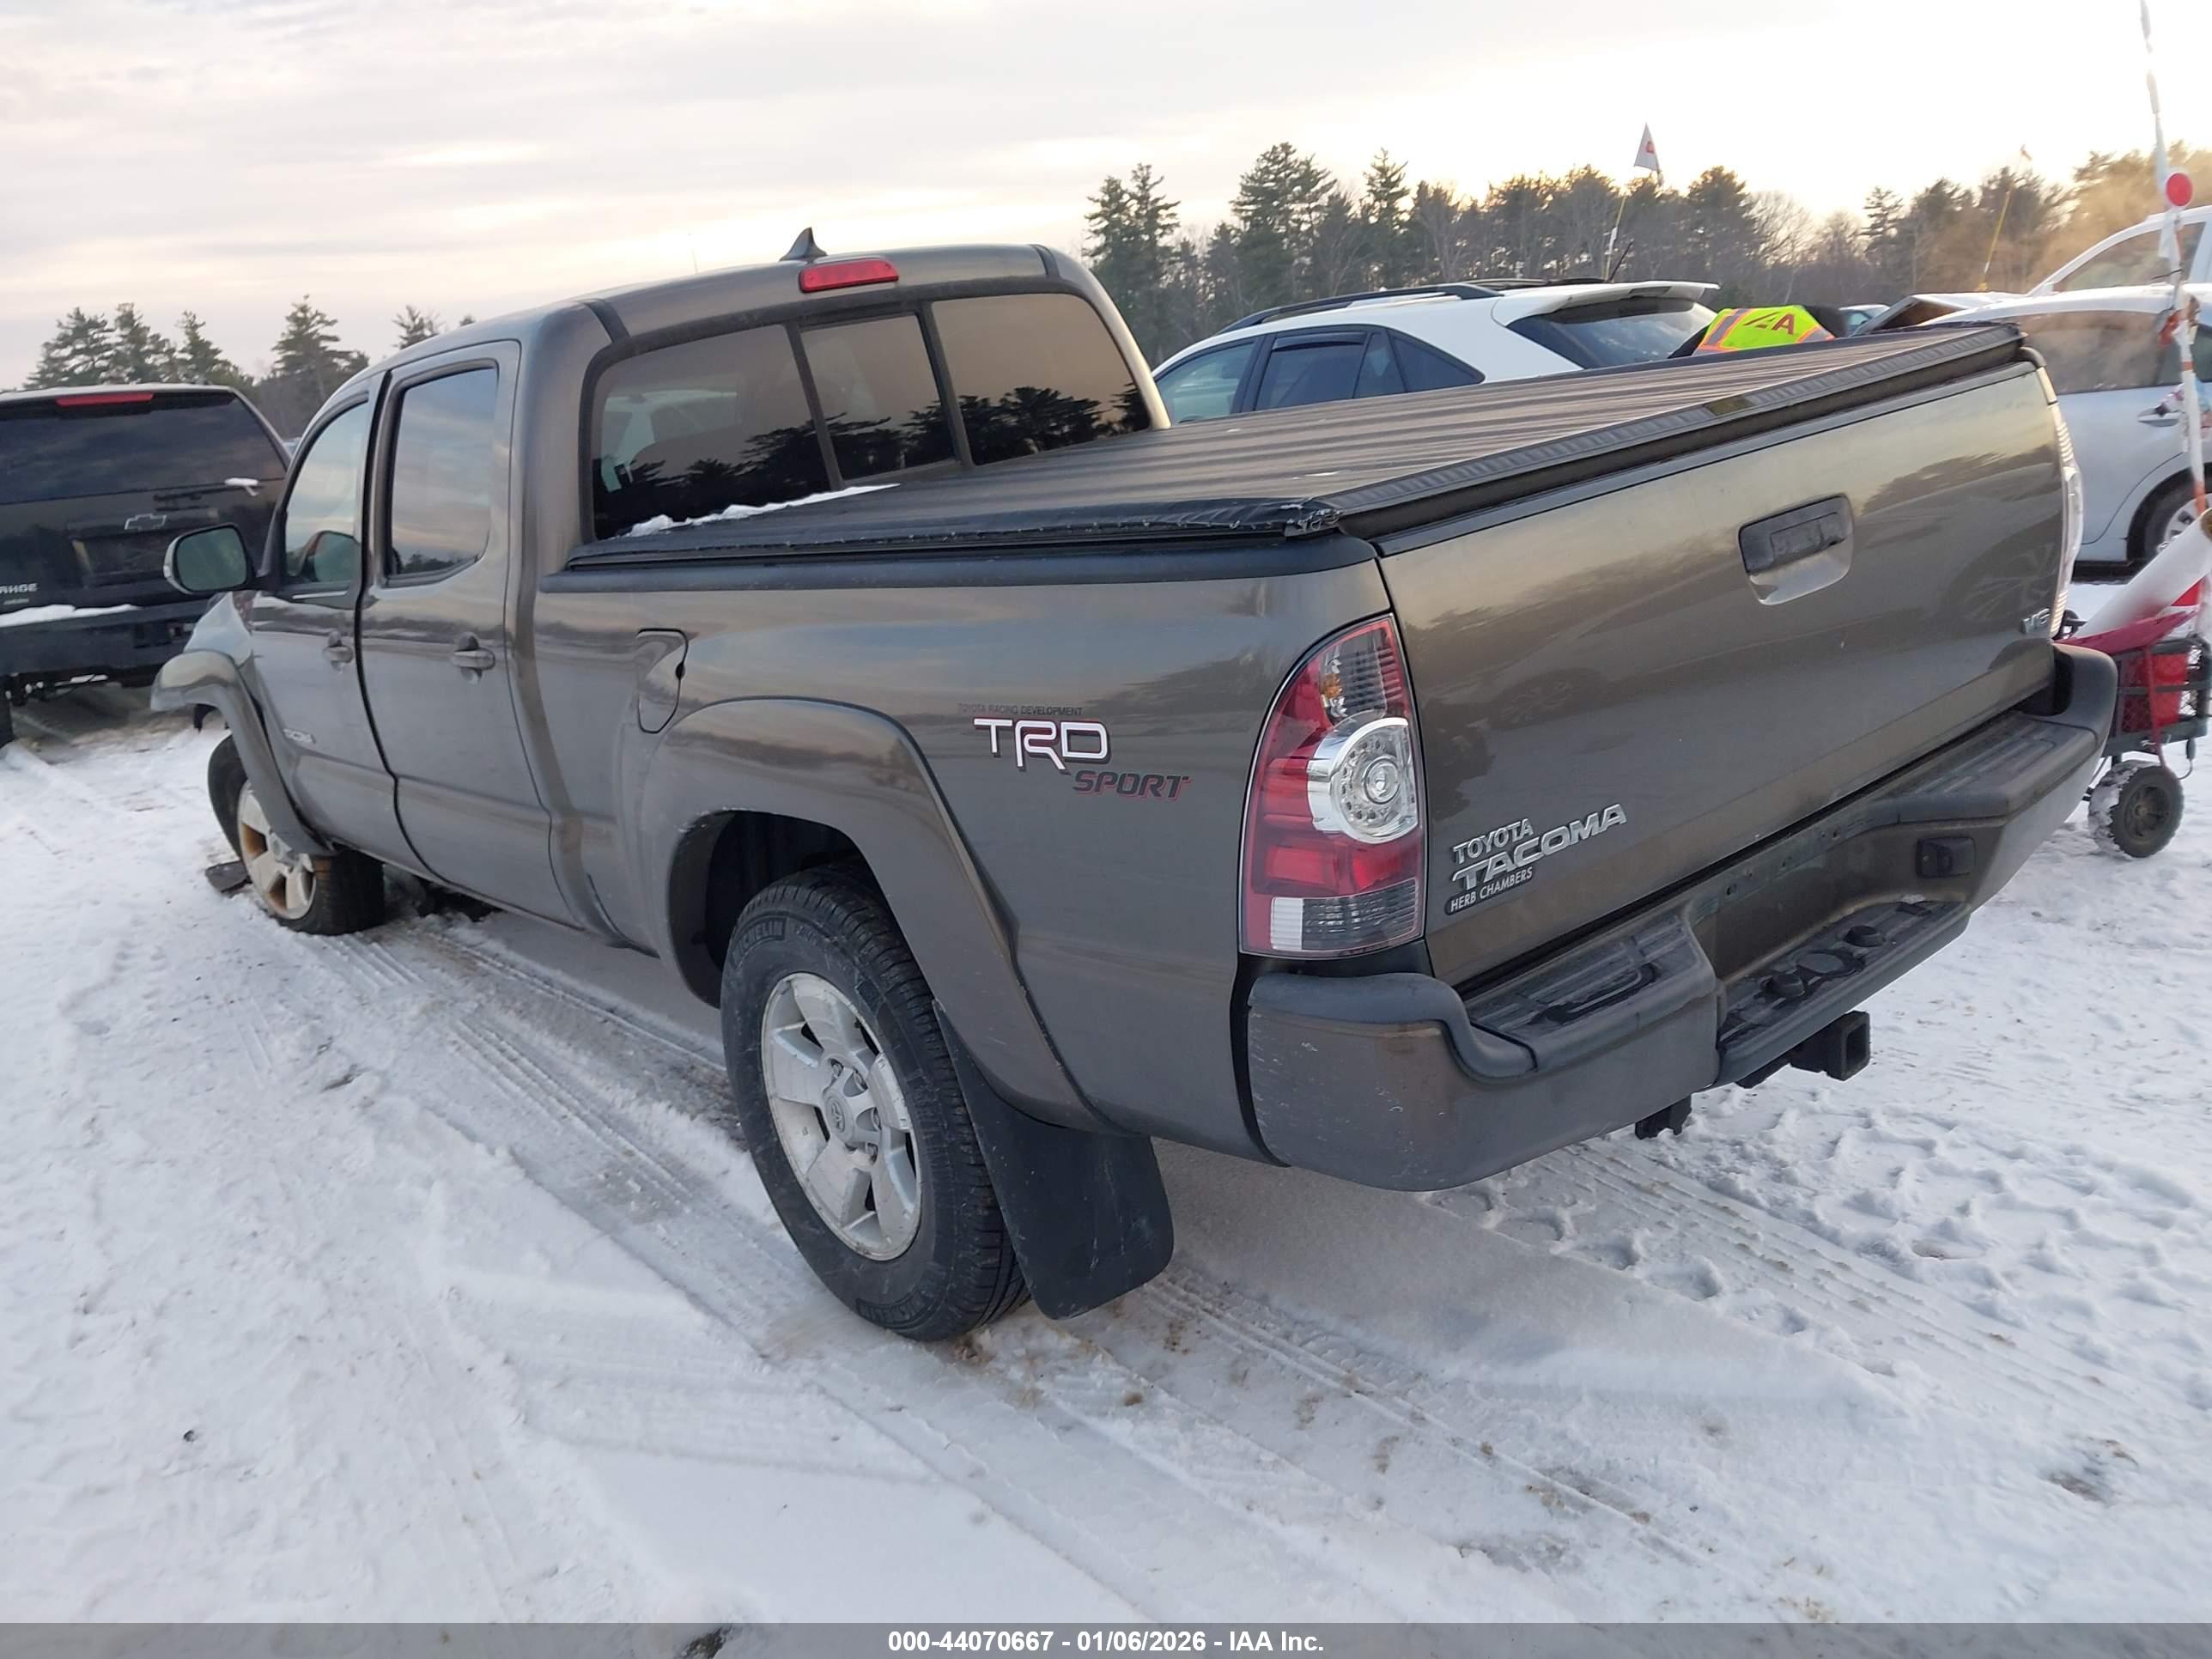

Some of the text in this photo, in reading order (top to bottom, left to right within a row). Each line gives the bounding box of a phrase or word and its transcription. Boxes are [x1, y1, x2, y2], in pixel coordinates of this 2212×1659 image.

[957, 702, 1084, 716] TOYOTA RACING DEVELOPMENT
[973, 717, 1110, 773] TRD
[1073, 770, 1192, 800] SPORT
[1452, 817, 1534, 864] TOYOTA
[1452, 803, 1627, 890] TACOMA
[1450, 866, 1533, 913] HERB CHAMBERS
